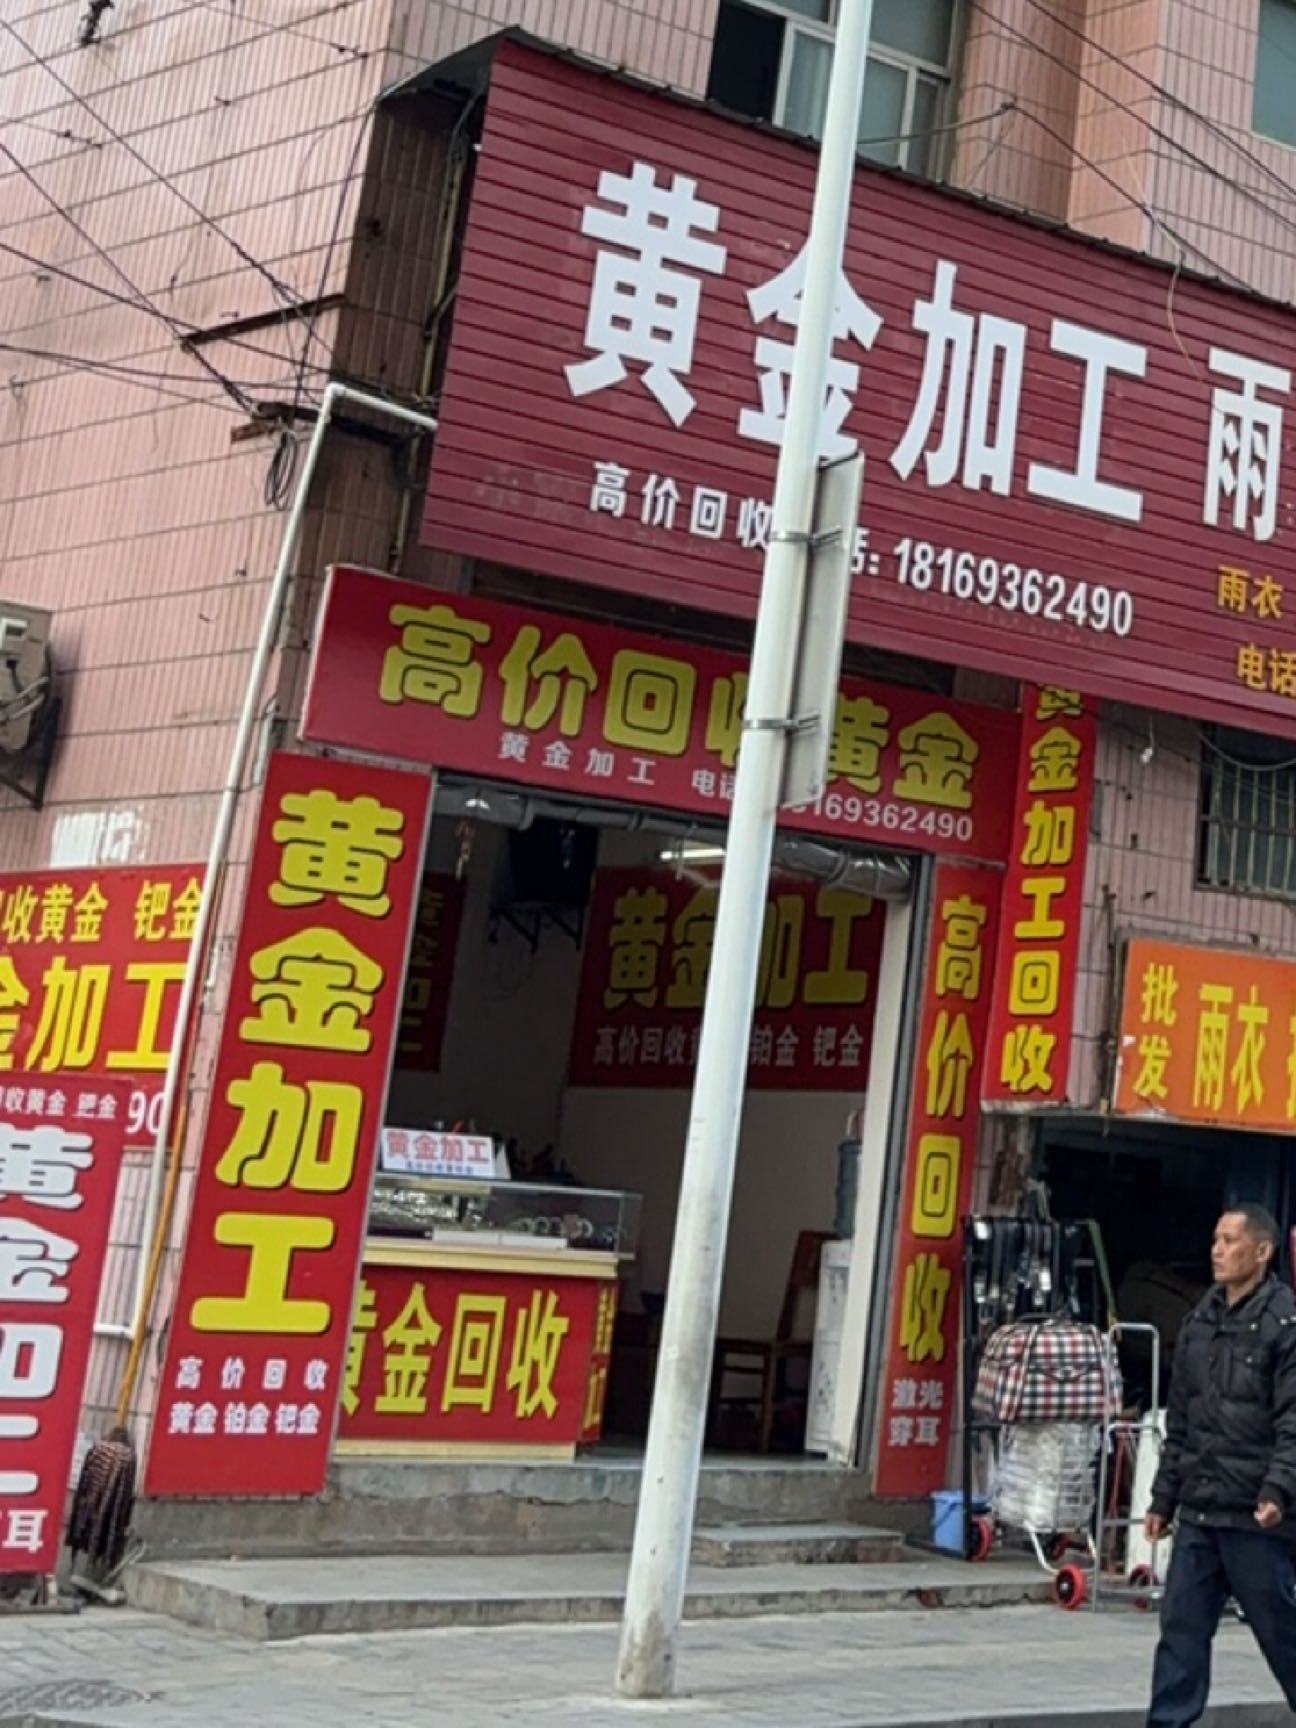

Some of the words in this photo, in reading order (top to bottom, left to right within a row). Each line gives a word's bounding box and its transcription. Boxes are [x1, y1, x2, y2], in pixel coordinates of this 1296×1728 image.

[563, 160, 1148, 523] 黄金加工
[589, 461, 774, 551] 高价回收
[1217, 565, 1284, 620] 雨衣
[498, 731, 656, 787] 黄金加工
[0, 880, 108, 944] 收黄金
[190, 788, 405, 1337] 黄金加工
[1133, 961, 1178, 1101] 批发
[1193, 982, 1269, 1117] 雨衣
[899, 894, 986, 1363] 高价回收
[175, 1355, 329, 1391] 高价回收
